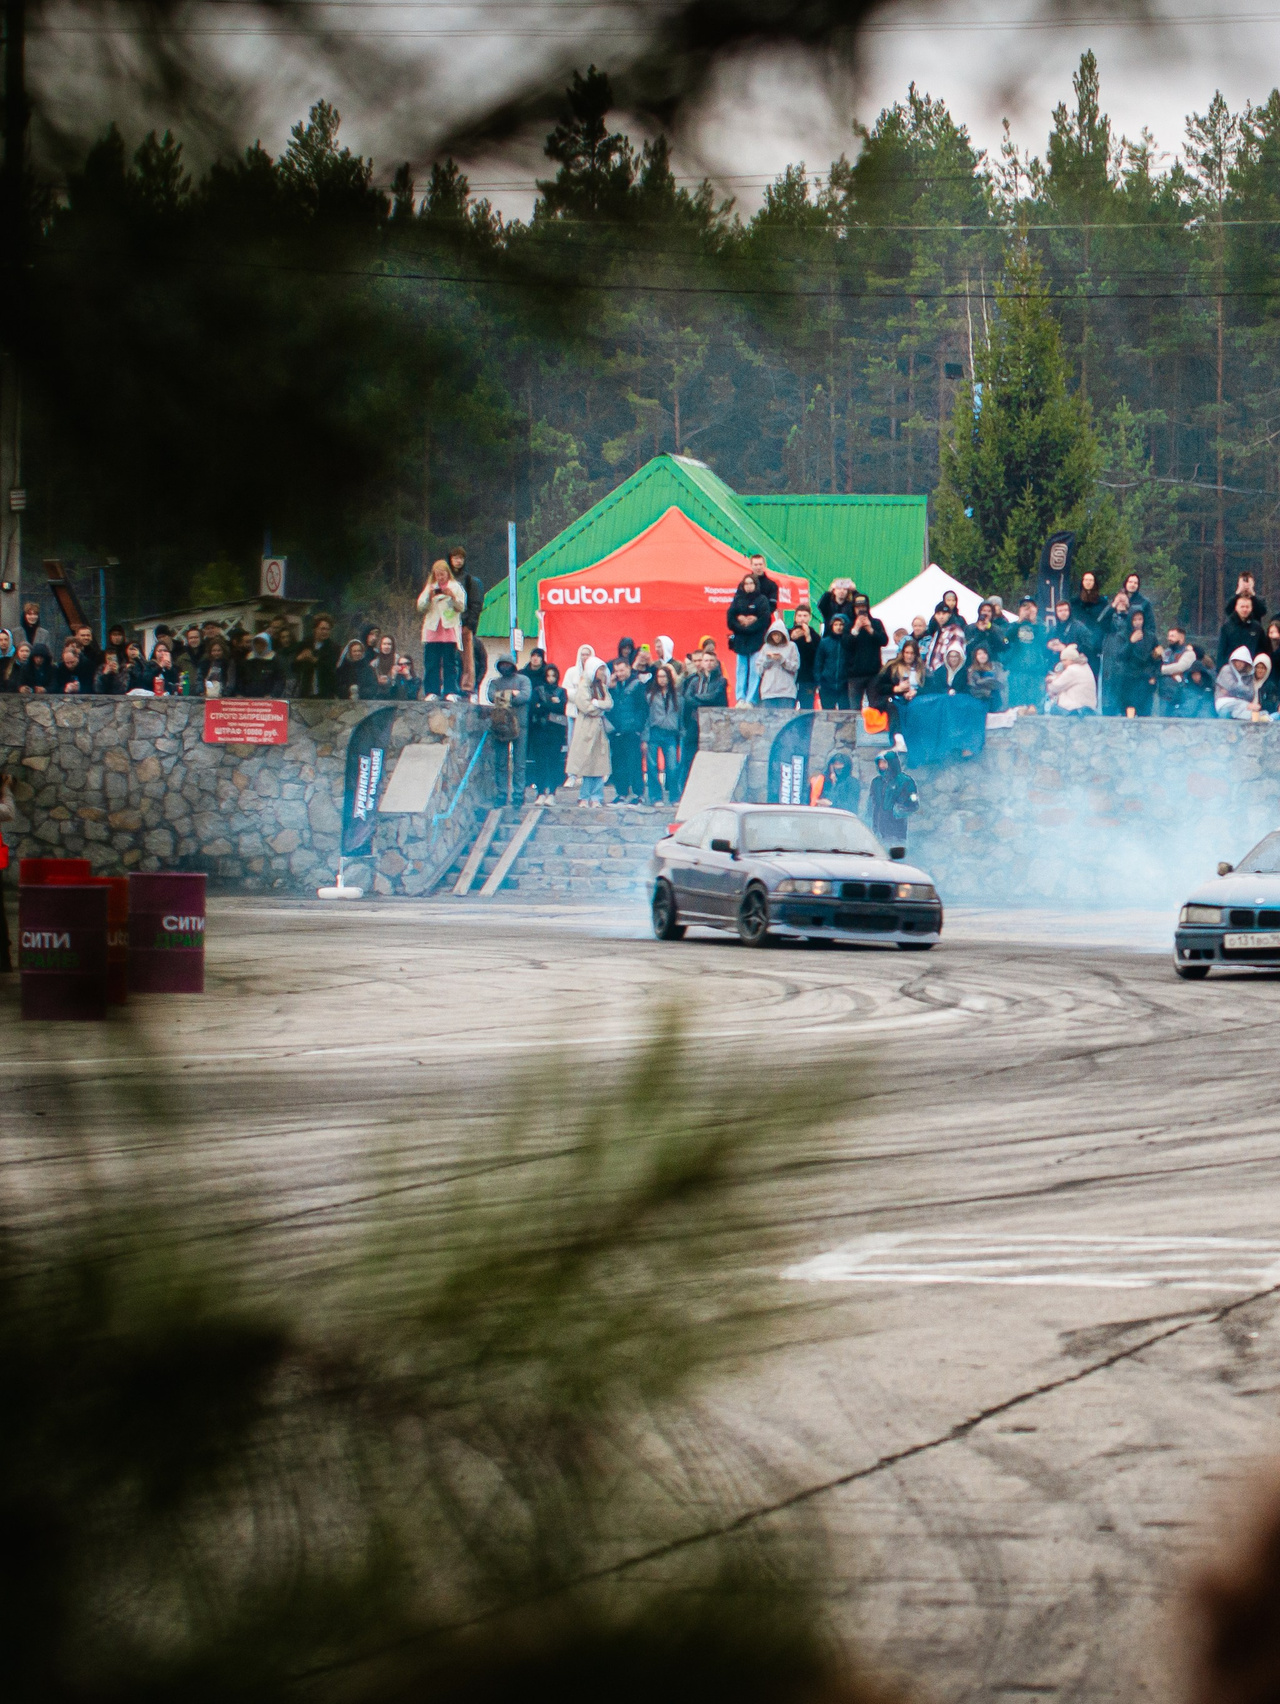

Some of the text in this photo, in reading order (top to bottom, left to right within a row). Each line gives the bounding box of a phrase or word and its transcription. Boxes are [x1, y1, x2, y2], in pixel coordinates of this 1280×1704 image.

[547, 585, 641, 605] auto.ru
[210, 712, 284, 722] СТРОГО ЗАПРЕЩЕНЫ
[214, 727, 242, 735] ШТРАФ
[369, 750, 381, 795] DARKSIDE
[354, 756, 370, 821] XPERIENCE
[781, 765, 791, 804] RIENCE
[21, 931, 71, 949] СИТИ
[153, 931, 204, 949] ДРАЙ
[20, 949, 81, 969] РАЙВ
